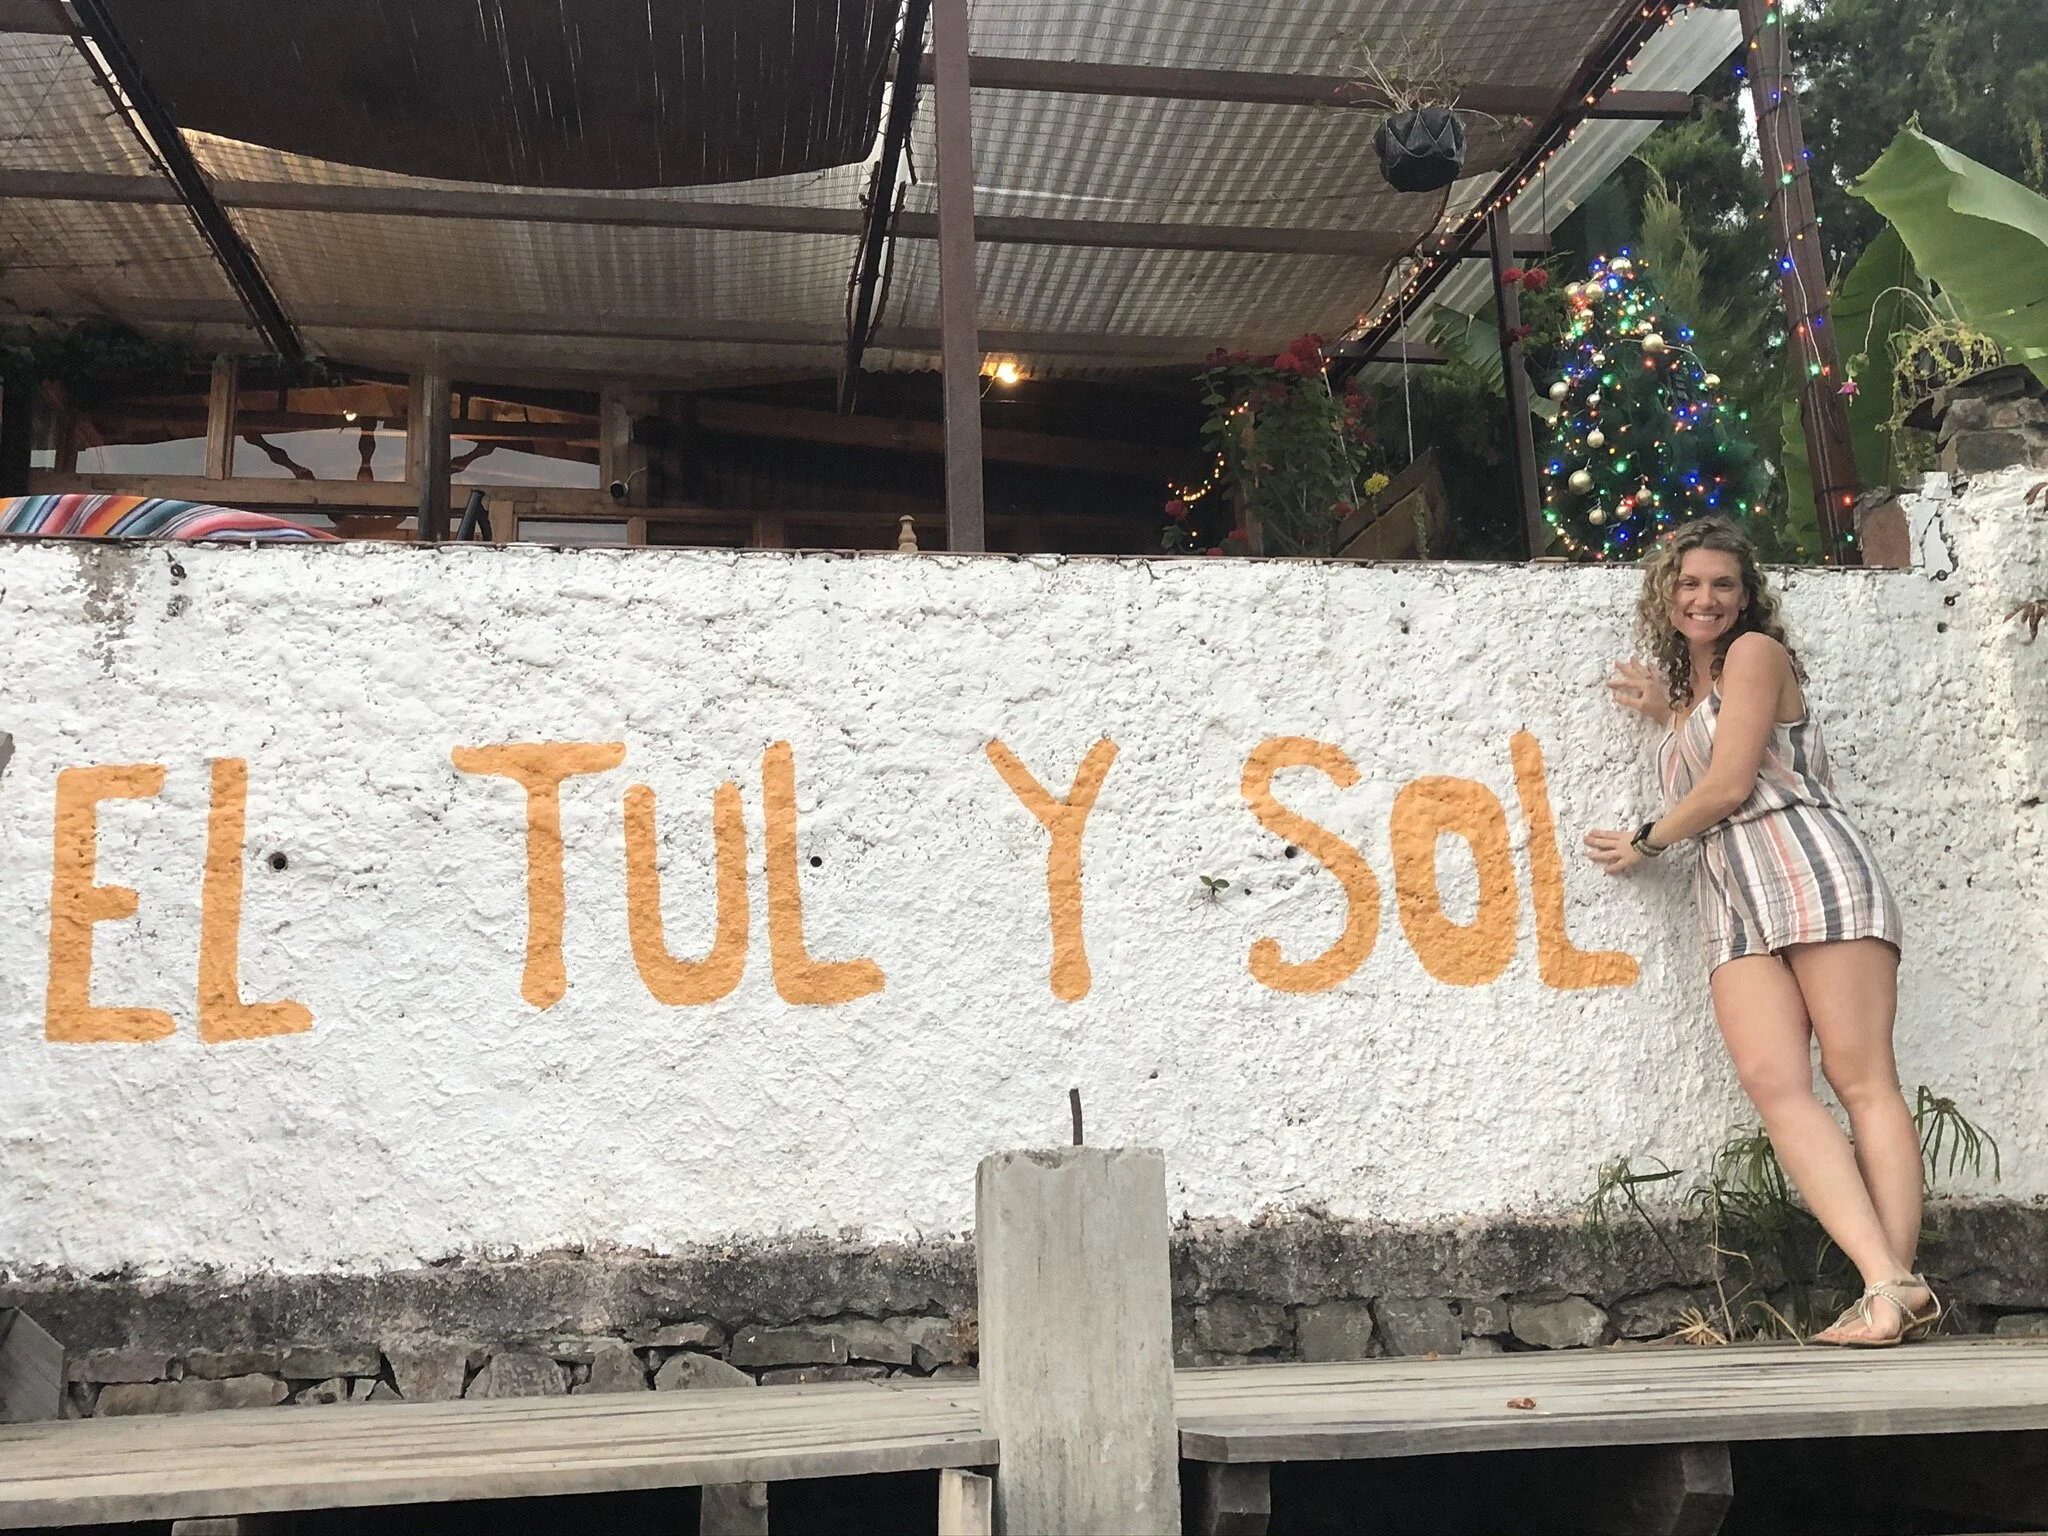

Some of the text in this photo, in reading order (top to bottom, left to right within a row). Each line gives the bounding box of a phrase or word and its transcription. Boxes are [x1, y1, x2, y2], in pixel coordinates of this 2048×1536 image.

[45, 731, 1641, 1043] EL TUL Y SOL
